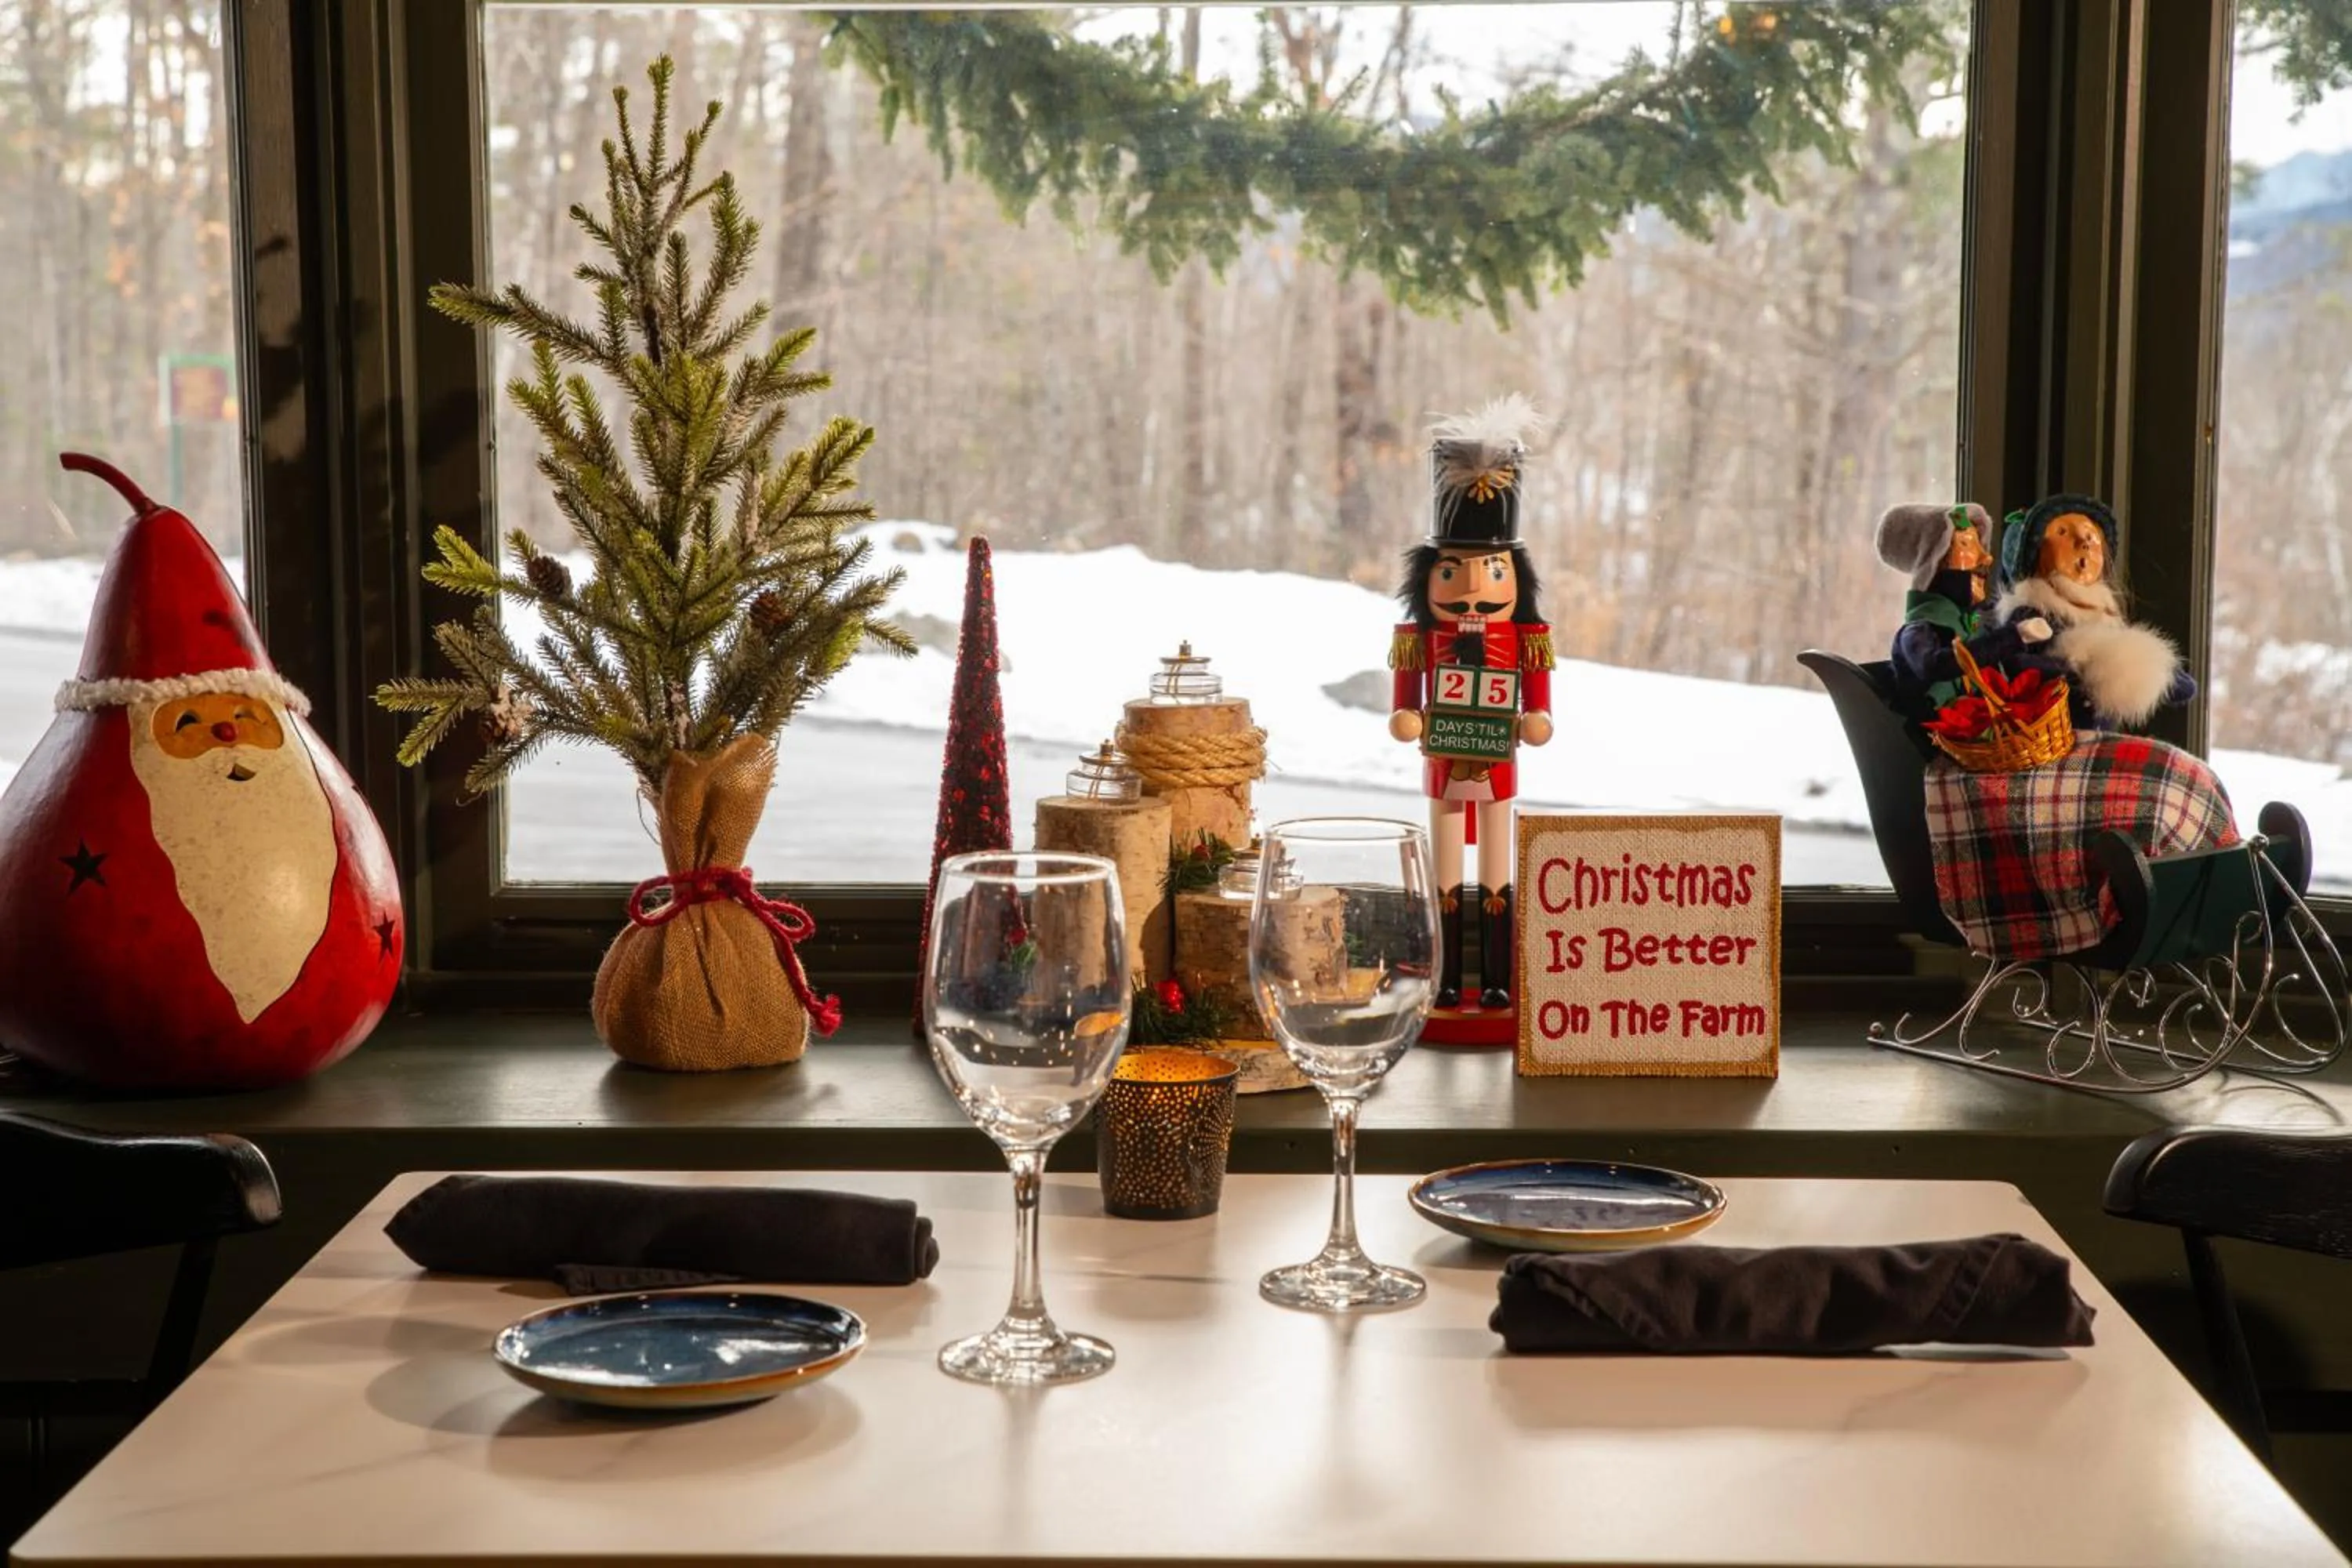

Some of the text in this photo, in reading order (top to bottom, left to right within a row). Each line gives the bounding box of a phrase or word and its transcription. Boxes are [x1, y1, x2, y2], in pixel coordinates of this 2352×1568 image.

[1436, 719, 1474, 735] DAYS
[1537, 852, 1755, 914] Christmas
[1545, 927, 1757, 974] Is Better
[1537, 999, 1766, 1040] On The Farm
